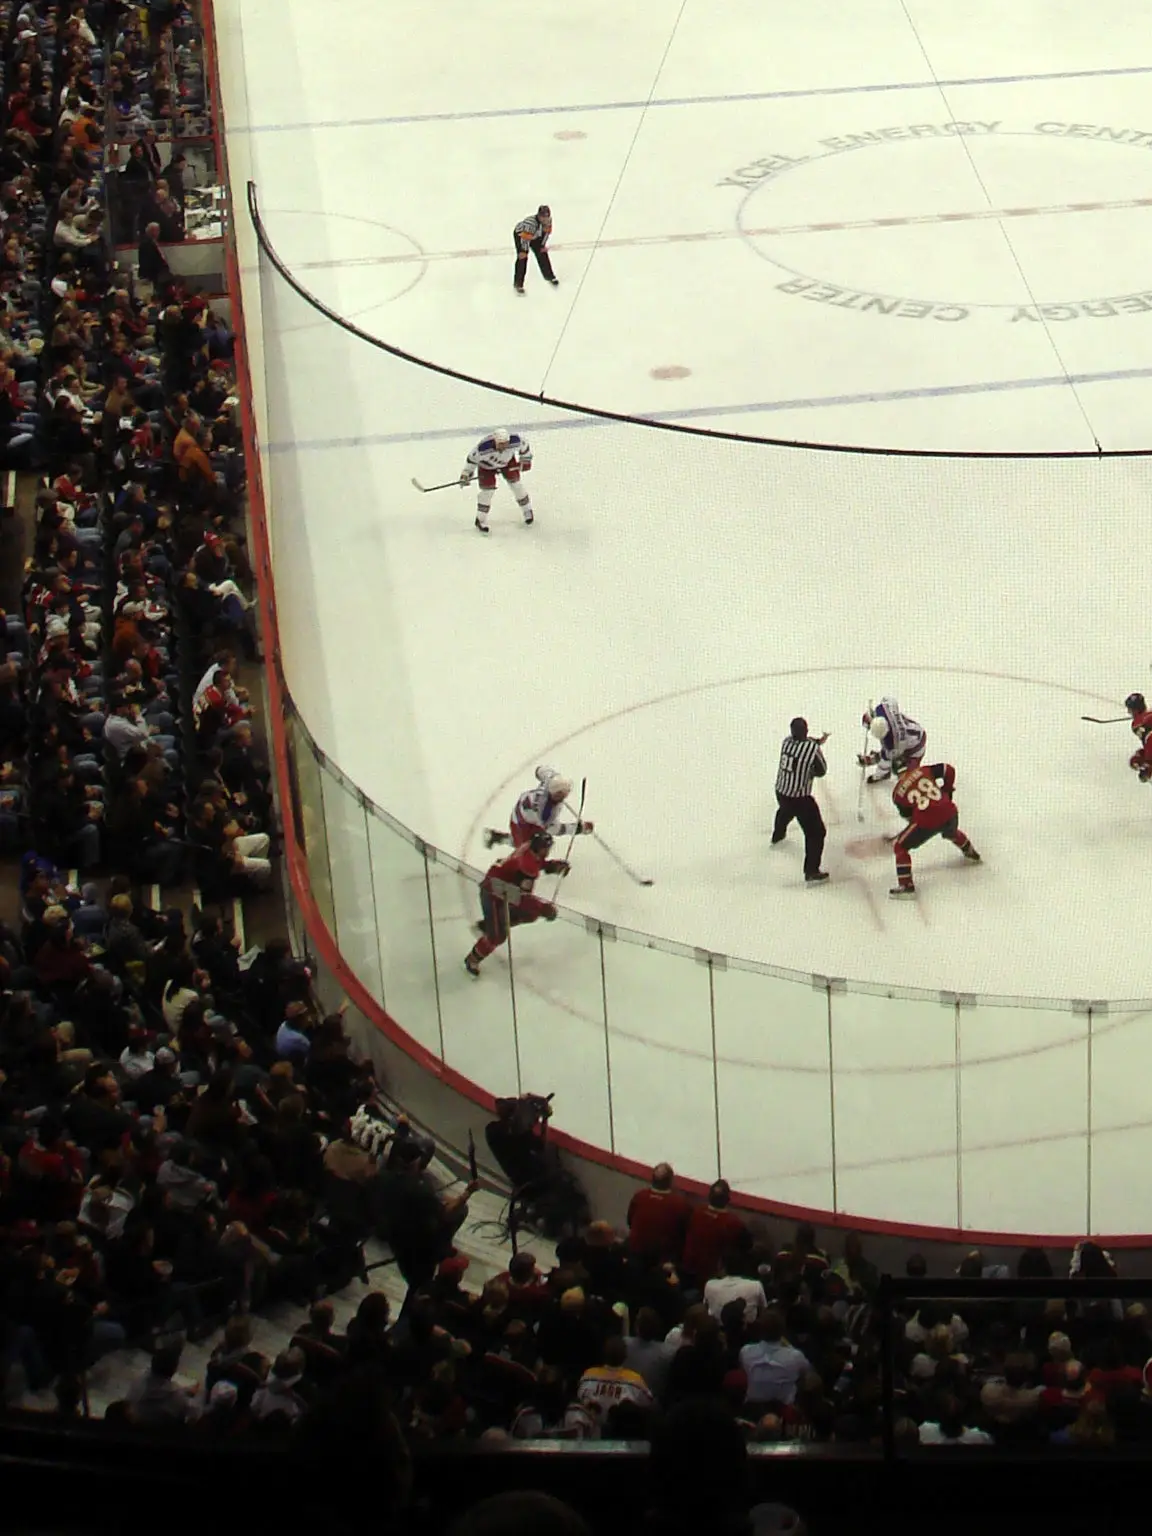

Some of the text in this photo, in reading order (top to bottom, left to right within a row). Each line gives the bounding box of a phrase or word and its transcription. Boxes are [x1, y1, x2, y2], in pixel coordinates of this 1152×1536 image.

[716, 152, 809, 190] XCEL
[819, 120, 1002, 152] ENERGY
[774, 277, 969, 322] CENTER
